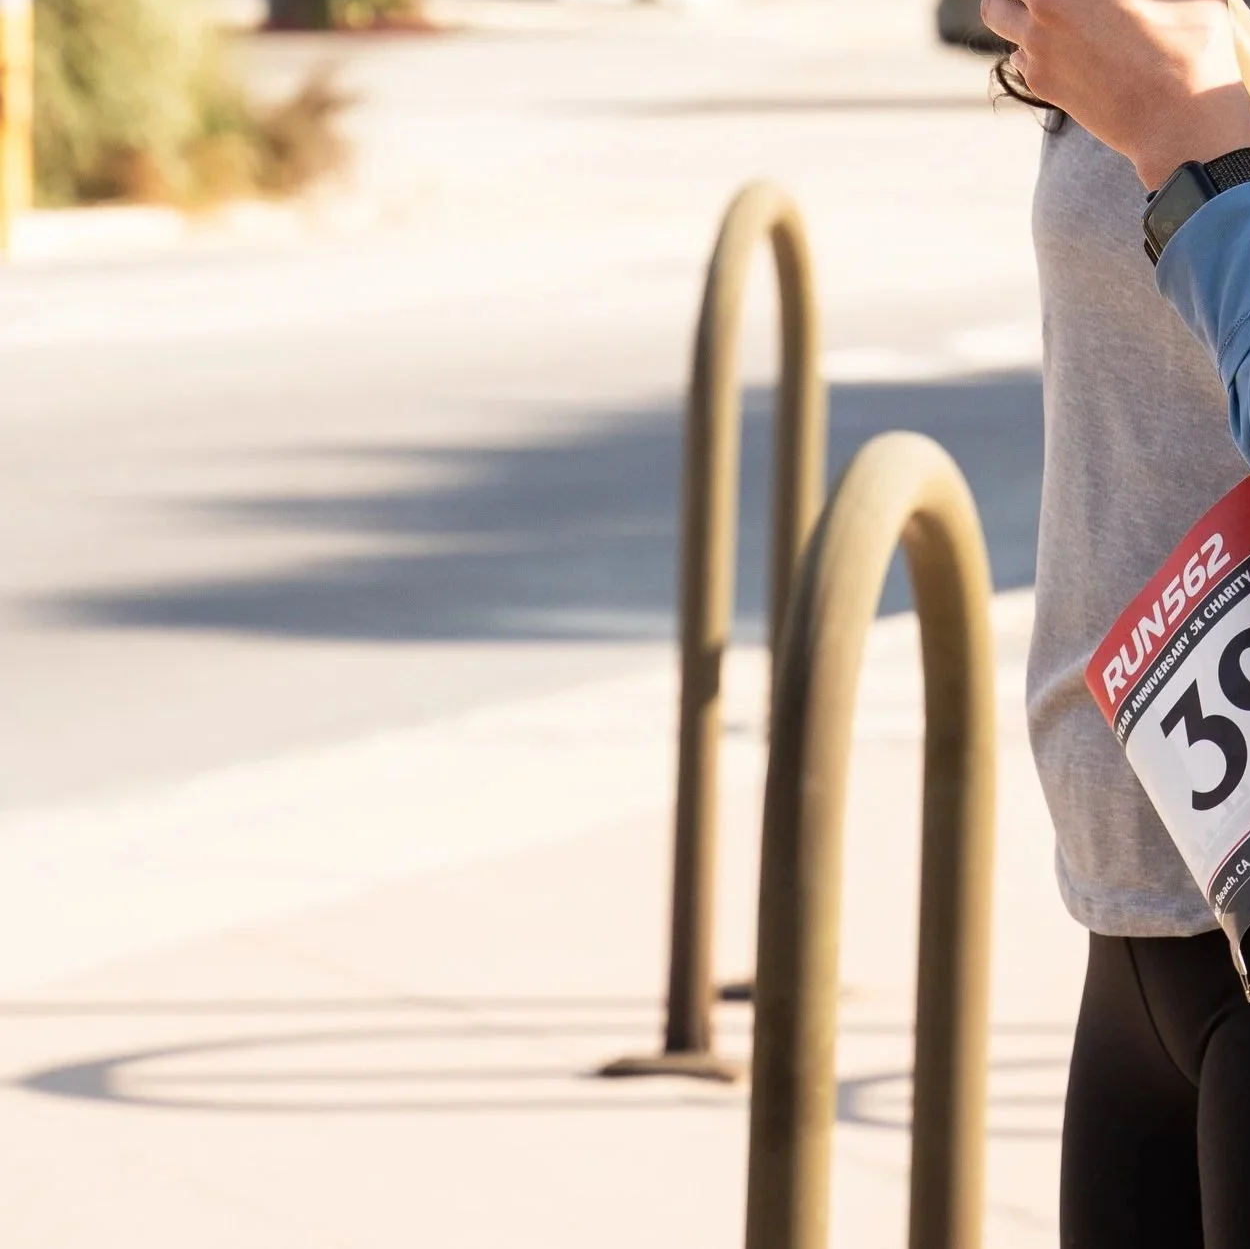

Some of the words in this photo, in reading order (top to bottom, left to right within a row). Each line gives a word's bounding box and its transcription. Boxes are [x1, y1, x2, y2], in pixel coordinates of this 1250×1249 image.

[1102, 532, 1231, 706] RUN562
[1117, 711, 1133, 739] YEAR
[1132, 632, 1190, 713] ANNIVERSARY
[1189, 617, 1205, 636] 5K
[1215, 875, 1239, 906] Beach,
[1235, 858, 1250, 876] CA
